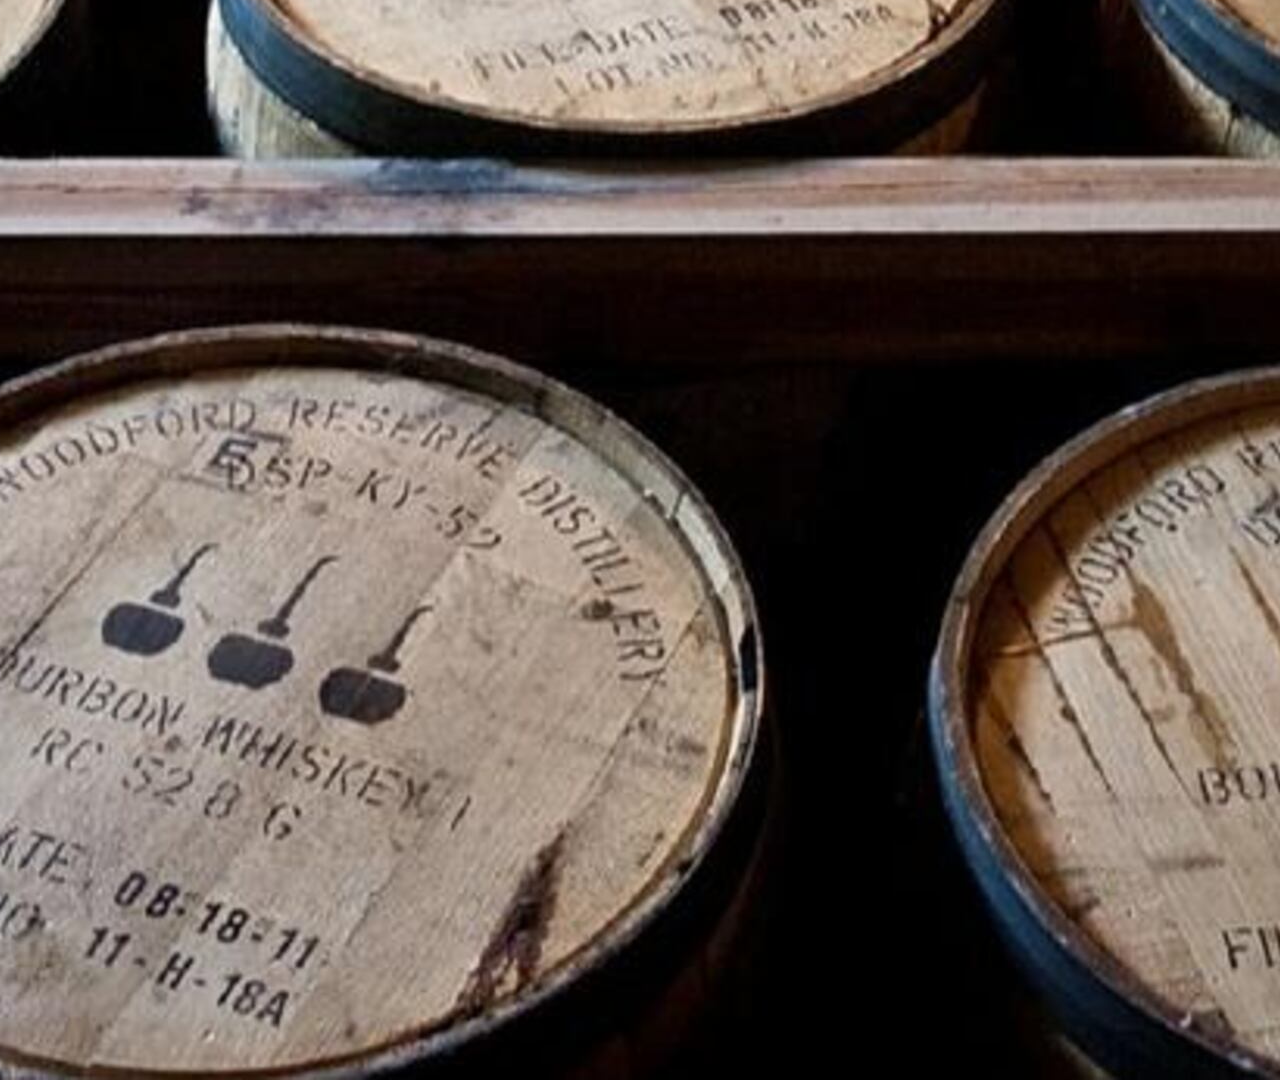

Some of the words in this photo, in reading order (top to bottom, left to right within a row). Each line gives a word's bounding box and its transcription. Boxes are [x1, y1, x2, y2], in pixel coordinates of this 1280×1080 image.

[287, 397, 520, 481] RESERVE
[520, 475, 670, 687] DISTILLERY
[1046, 461, 1228, 638] WOODFORD
[29, 726, 104, 773] RC
[201, 715, 452, 818] WHISKEY
[113, 870, 324, 971] 08-18-11
[84, 926, 296, 1027] 11-H-18A
